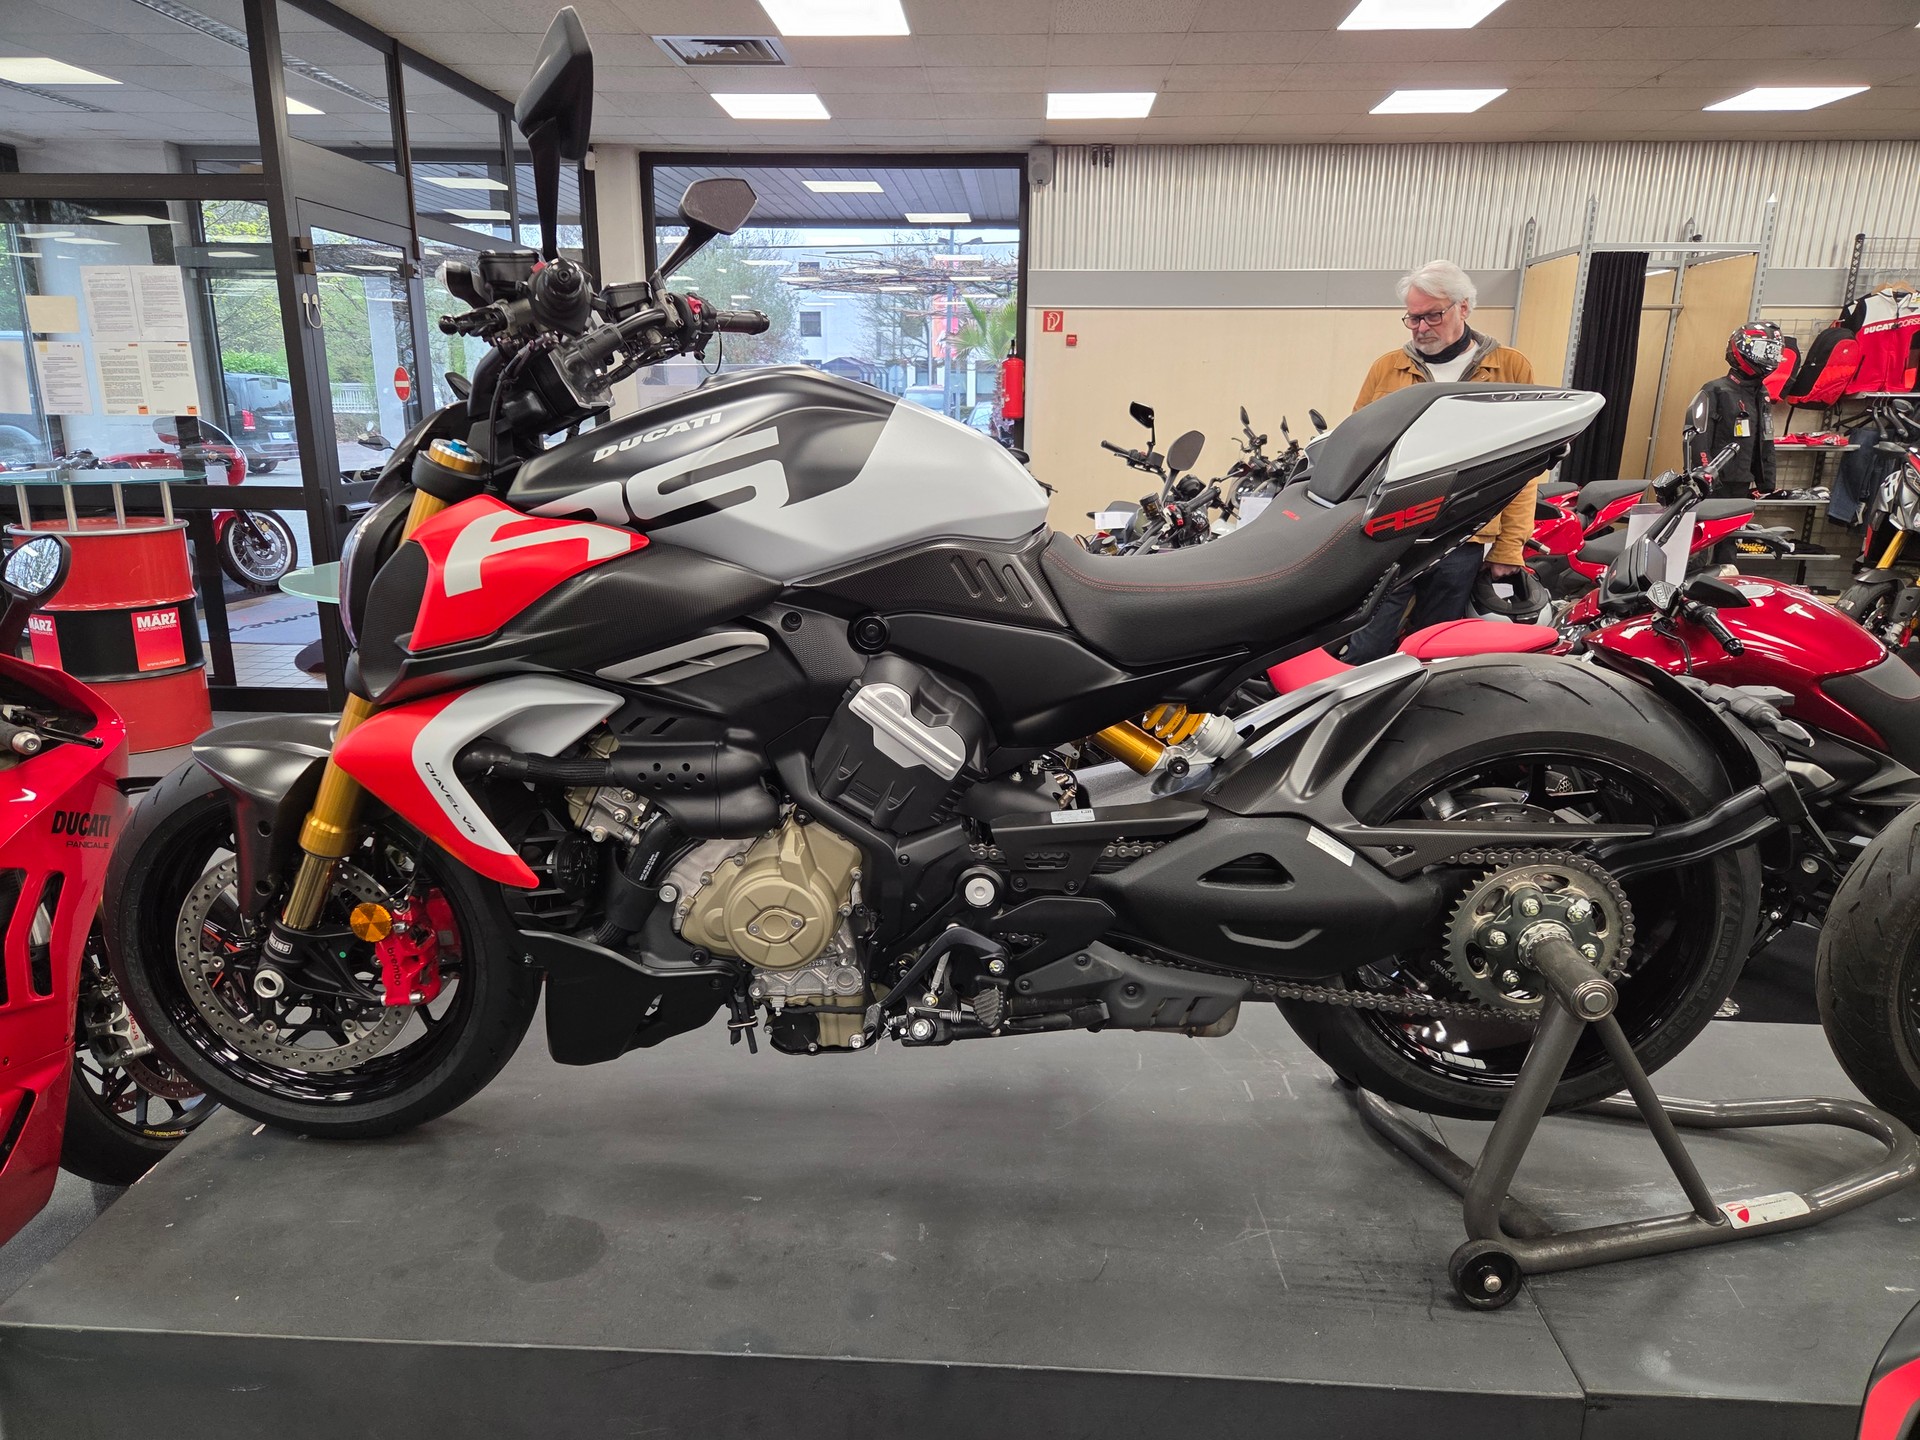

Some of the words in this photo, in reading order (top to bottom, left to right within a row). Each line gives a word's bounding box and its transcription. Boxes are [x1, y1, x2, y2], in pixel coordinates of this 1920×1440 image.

[1864, 321, 1896, 335] DUCAT
[593, 412, 722, 462] DUCATI
[136, 612, 177, 629] MÄRZ
[425, 762, 460, 815] DIAVEL
[462, 816, 477, 834] V4
[51, 810, 111, 838] DUCATI
[66, 841, 110, 849] PANIGALE
[387, 947, 401, 986] brembo
